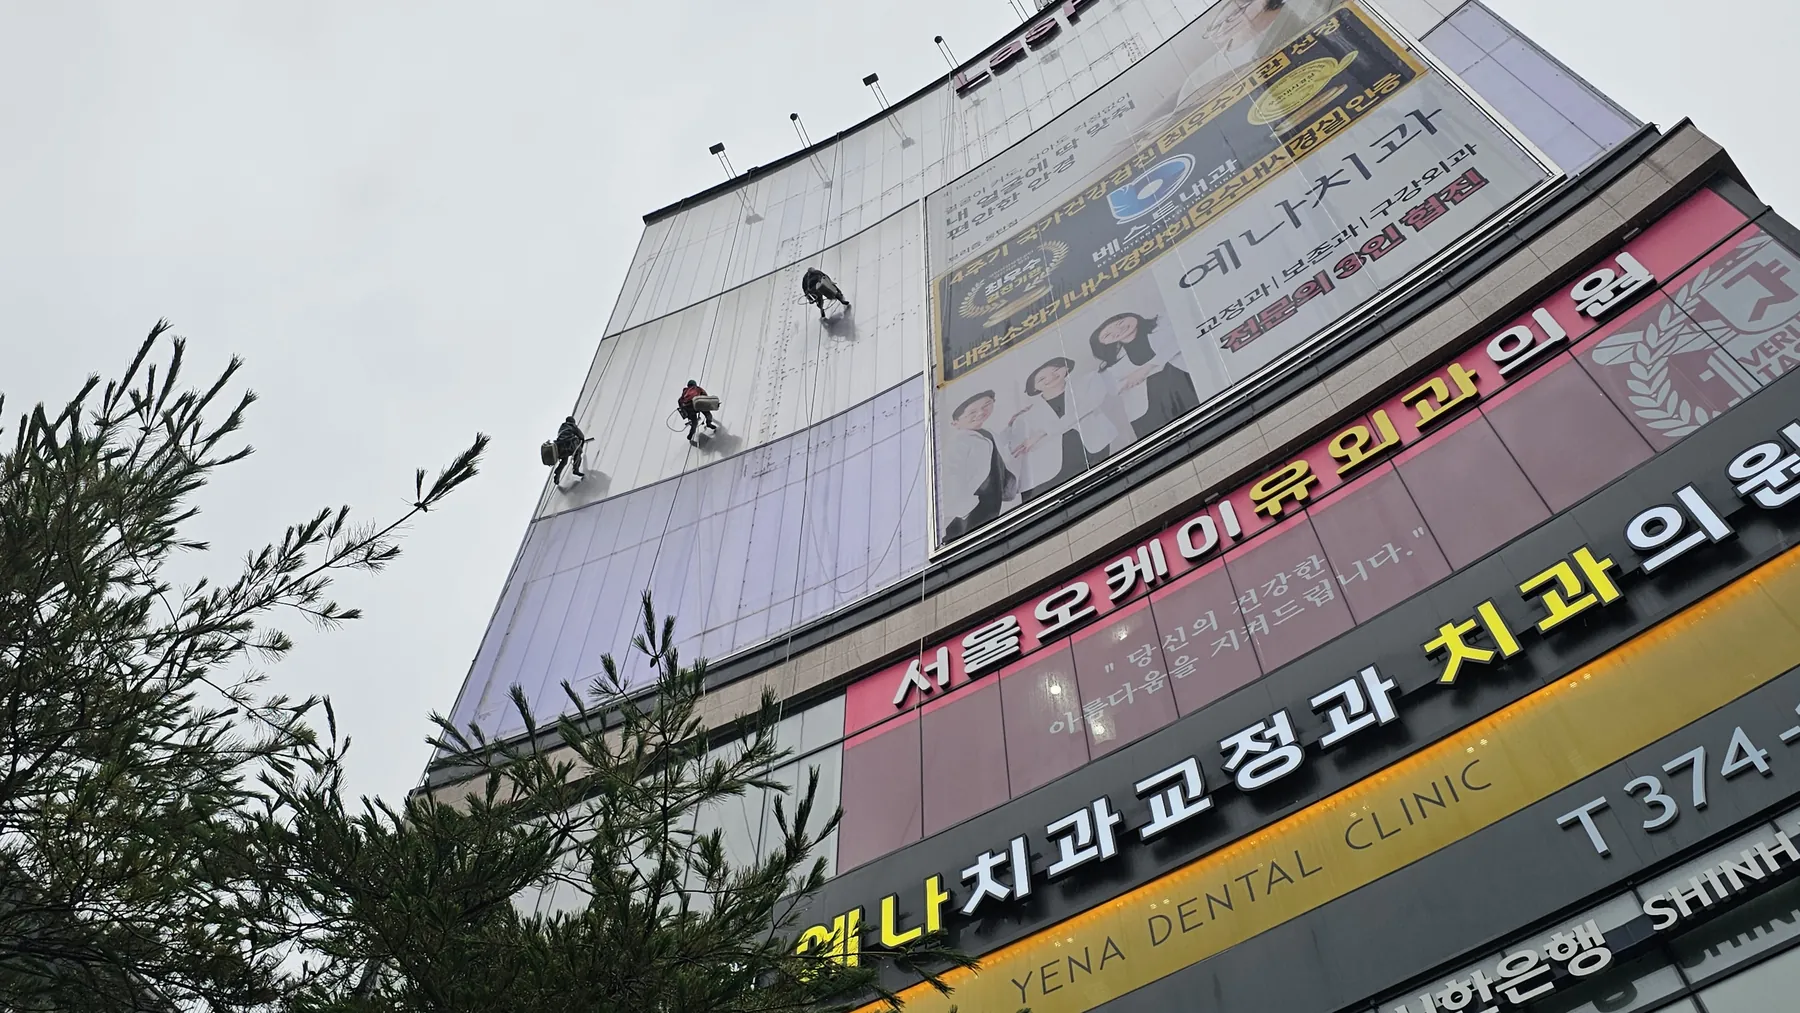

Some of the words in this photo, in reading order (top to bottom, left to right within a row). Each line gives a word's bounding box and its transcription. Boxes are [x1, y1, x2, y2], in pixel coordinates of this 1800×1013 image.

[946, 208, 968, 226] 내
[977, 158, 1049, 208] 얼굴에
[1055, 138, 1080, 156] 딱
[1087, 100, 1136, 138] 맞춰
[946, 192, 1021, 240] 편안한
[1028, 154, 1076, 191] 안경
[950, 244, 1008, 285] 4주기
[1016, 148, 1157, 246] 국가건강검진
[1164, 57, 1285, 147] 최우수기관
[1291, 17, 1341, 55] 선정
[1092, 159, 1237, 262] 베스트내과
[1179, 109, 1442, 289] 예나치과
[953, 215, 1192, 370] 대한소화기내시경학회
[1195, 110, 1346, 219] 우수내시경실
[1346, 72, 1401, 113] 인증
[1195, 283, 1271, 339] 교정과
[1282, 223, 1360, 283] 보존과
[1369, 143, 1477, 220] 구강외과
[1220, 269, 1336, 353] 전문의
[1333, 222, 1407, 280] 3인
[1400, 166, 1490, 233] 협진
[1737, 315, 1800, 367] VERI
[1757, 343, 1800, 379] TA
[1231, 554, 1325, 615] 건강한
[1049, 654, 1200, 735] 아름다움을
[1556, 795, 1611, 858] T
[1623, 703, 1800, 831] 374-
[1010, 936, 1128, 1005] YENA
[1147, 849, 1324, 948] DENTAL
[1344, 758, 1492, 850] CLINIC
[1643, 821, 1800, 931] SHINH
